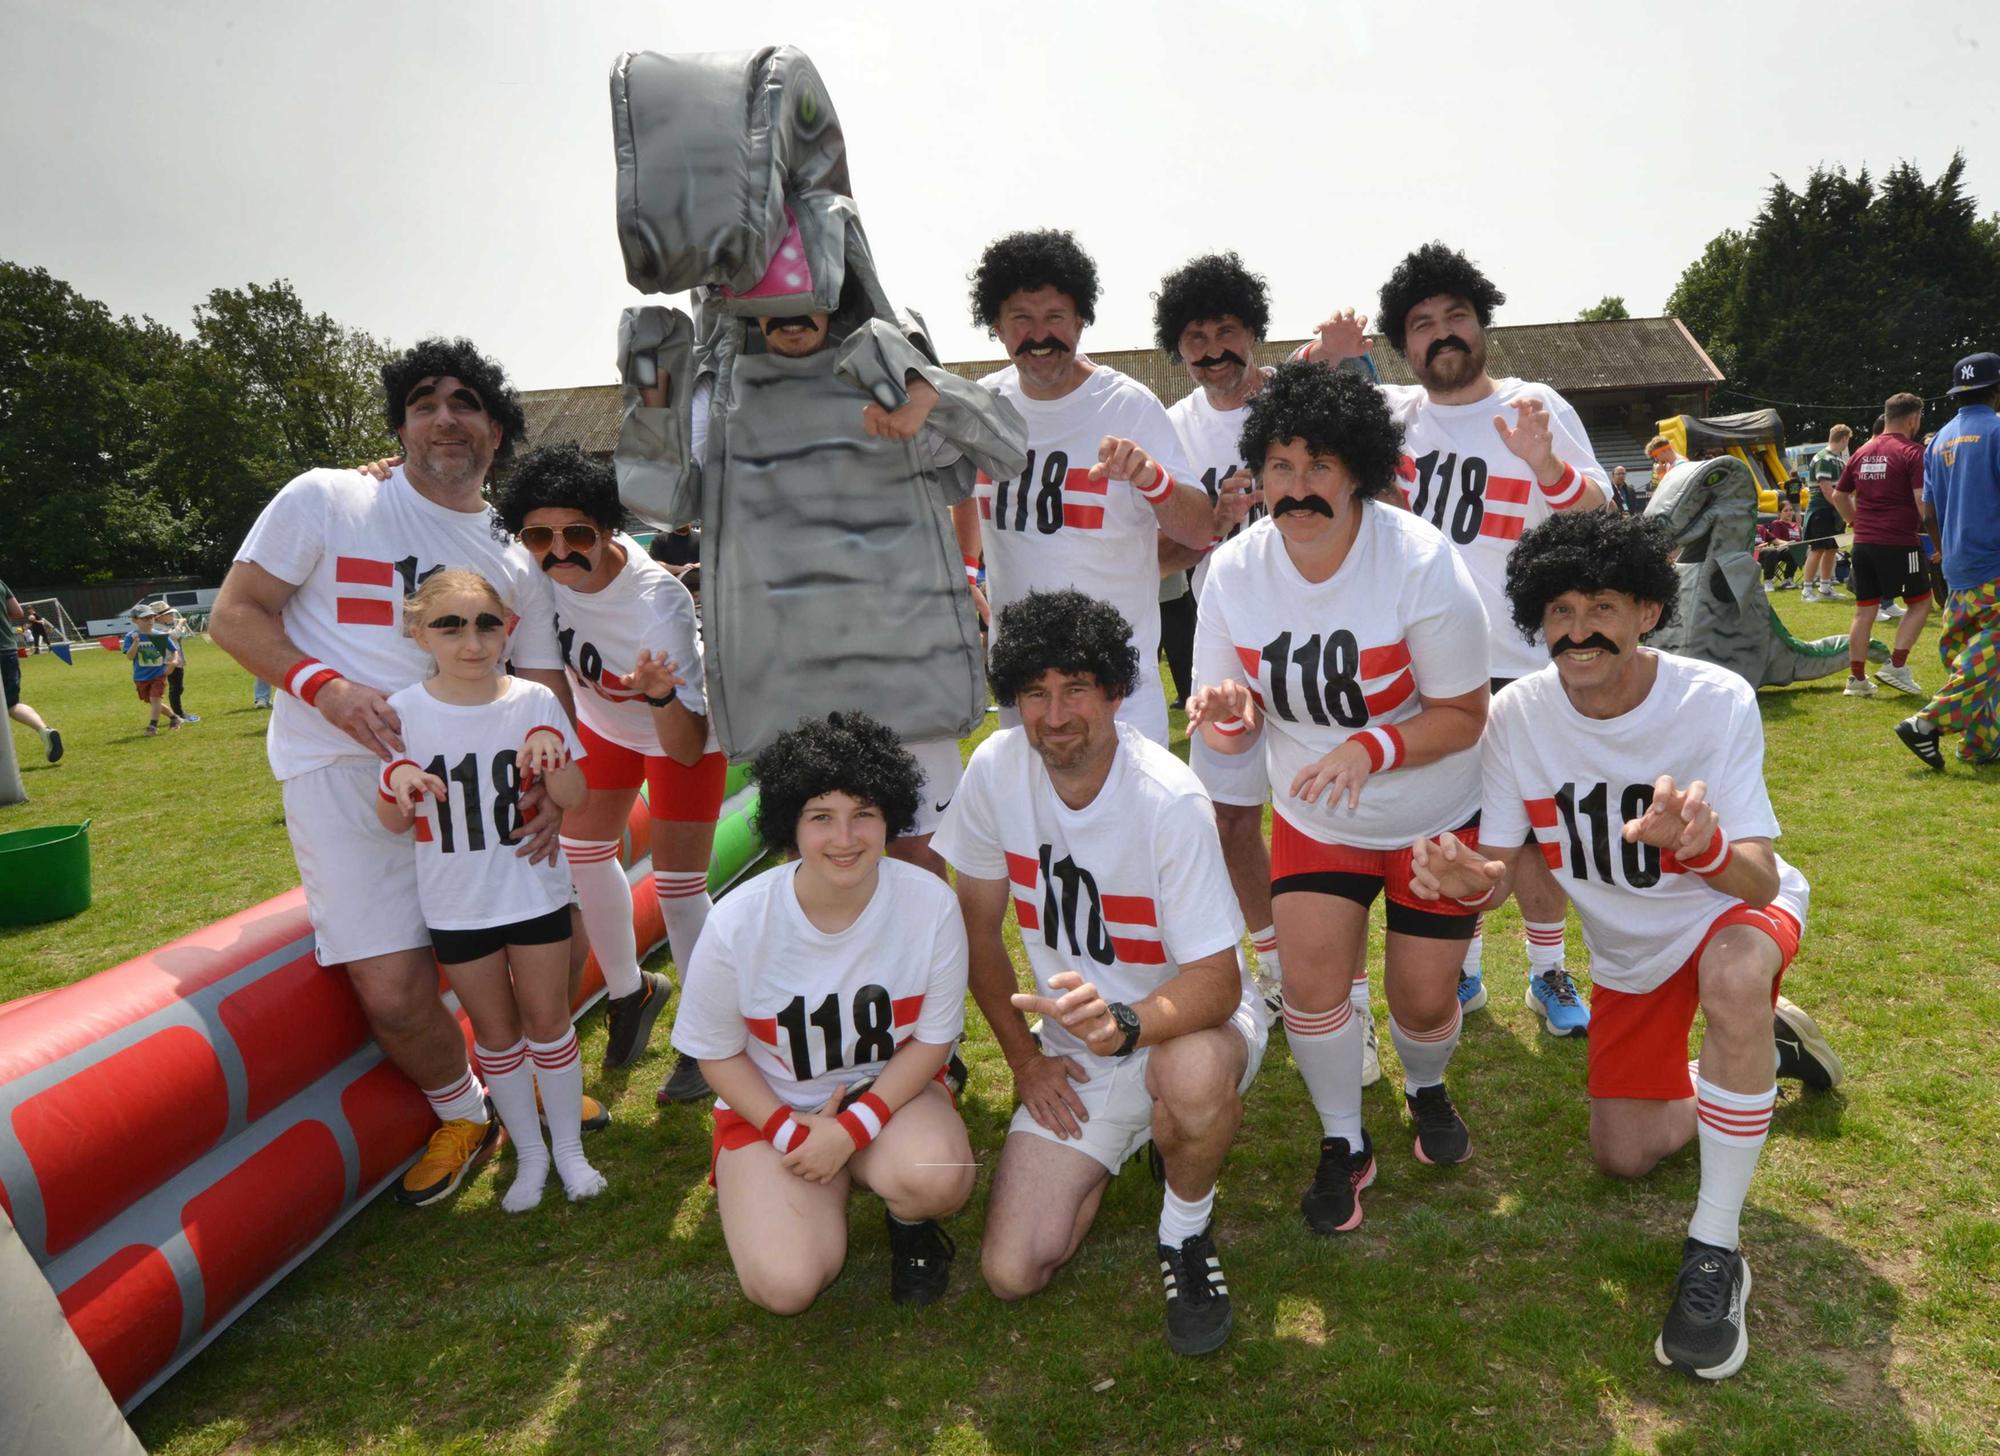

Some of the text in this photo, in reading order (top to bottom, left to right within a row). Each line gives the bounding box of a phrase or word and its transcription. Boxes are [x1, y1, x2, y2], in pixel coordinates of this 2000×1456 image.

[1413, 450, 1487, 545] 118
[1858, 472, 1887, 480] HEALTH
[1862, 455, 1889, 463] SUSSEX
[1262, 629, 1370, 728] 118
[424, 749, 524, 853] 118
[1554, 782, 1661, 888] 118
[777, 984, 895, 1081] 118
